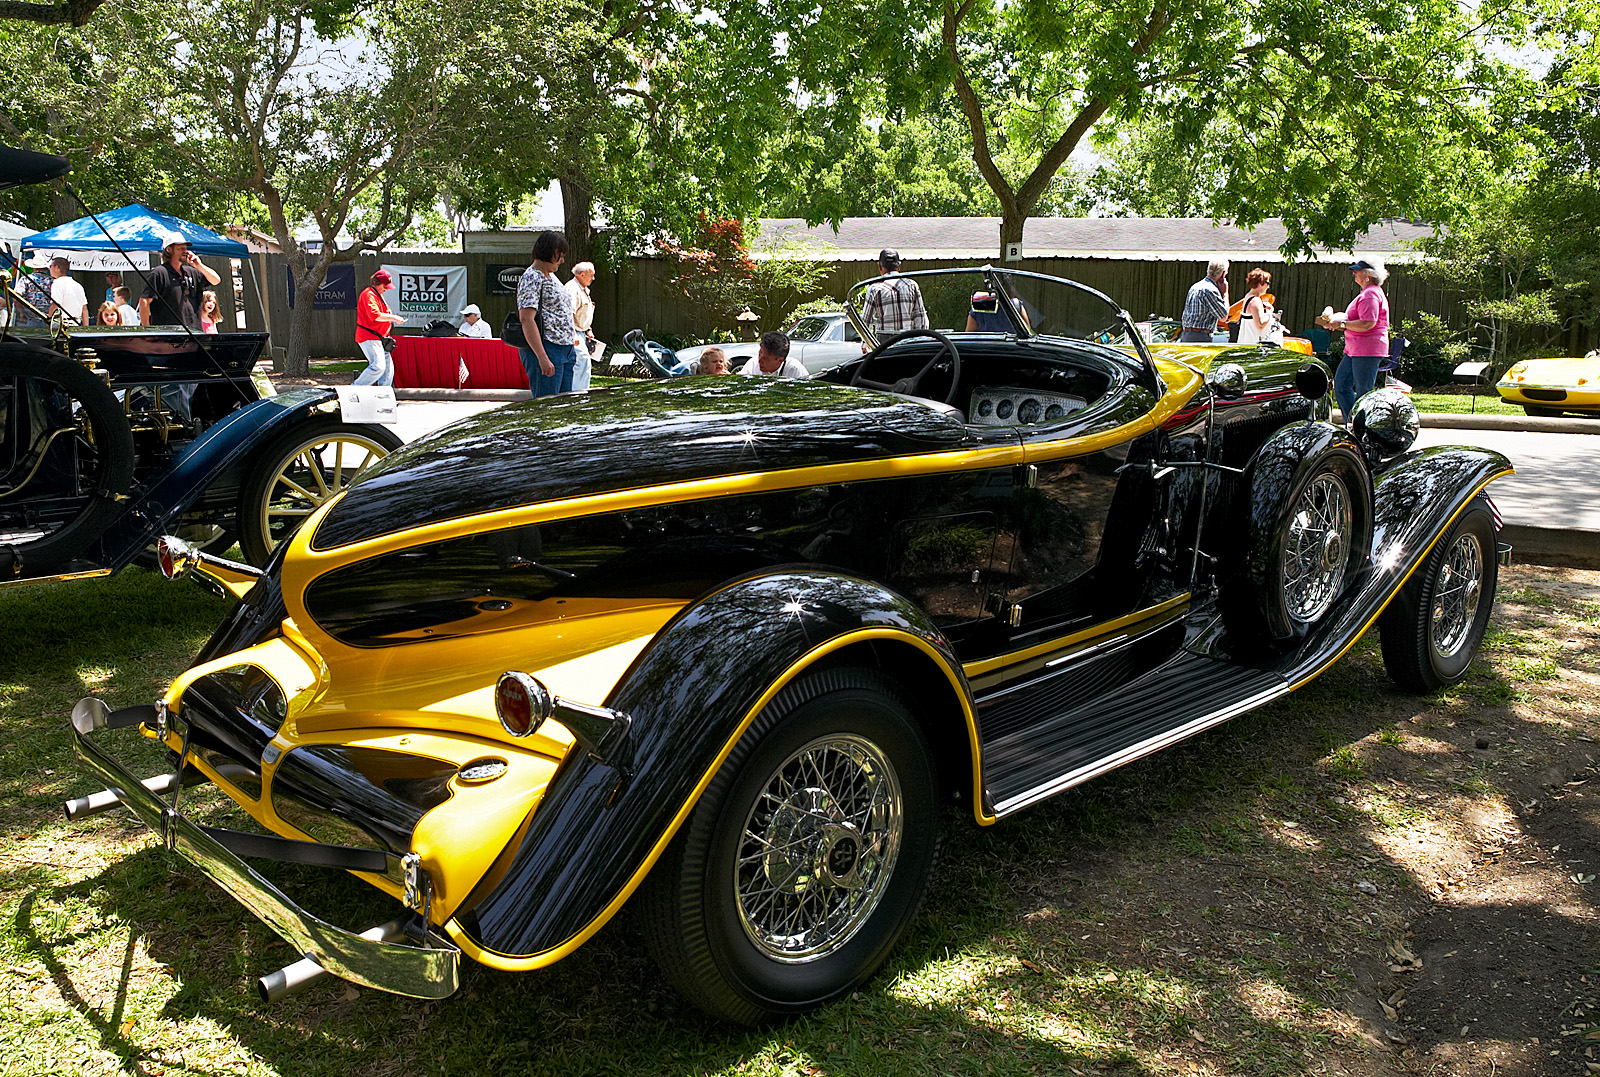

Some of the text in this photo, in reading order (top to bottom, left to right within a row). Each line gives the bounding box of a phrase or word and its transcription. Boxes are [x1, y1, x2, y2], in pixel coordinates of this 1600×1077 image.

[1010, 247, 1018, 257] B
[83, 252, 98, 270] of
[401, 275, 445, 292] BIZ
[401, 291, 445, 302] RADIO
[400, 302, 447, 312] Network
